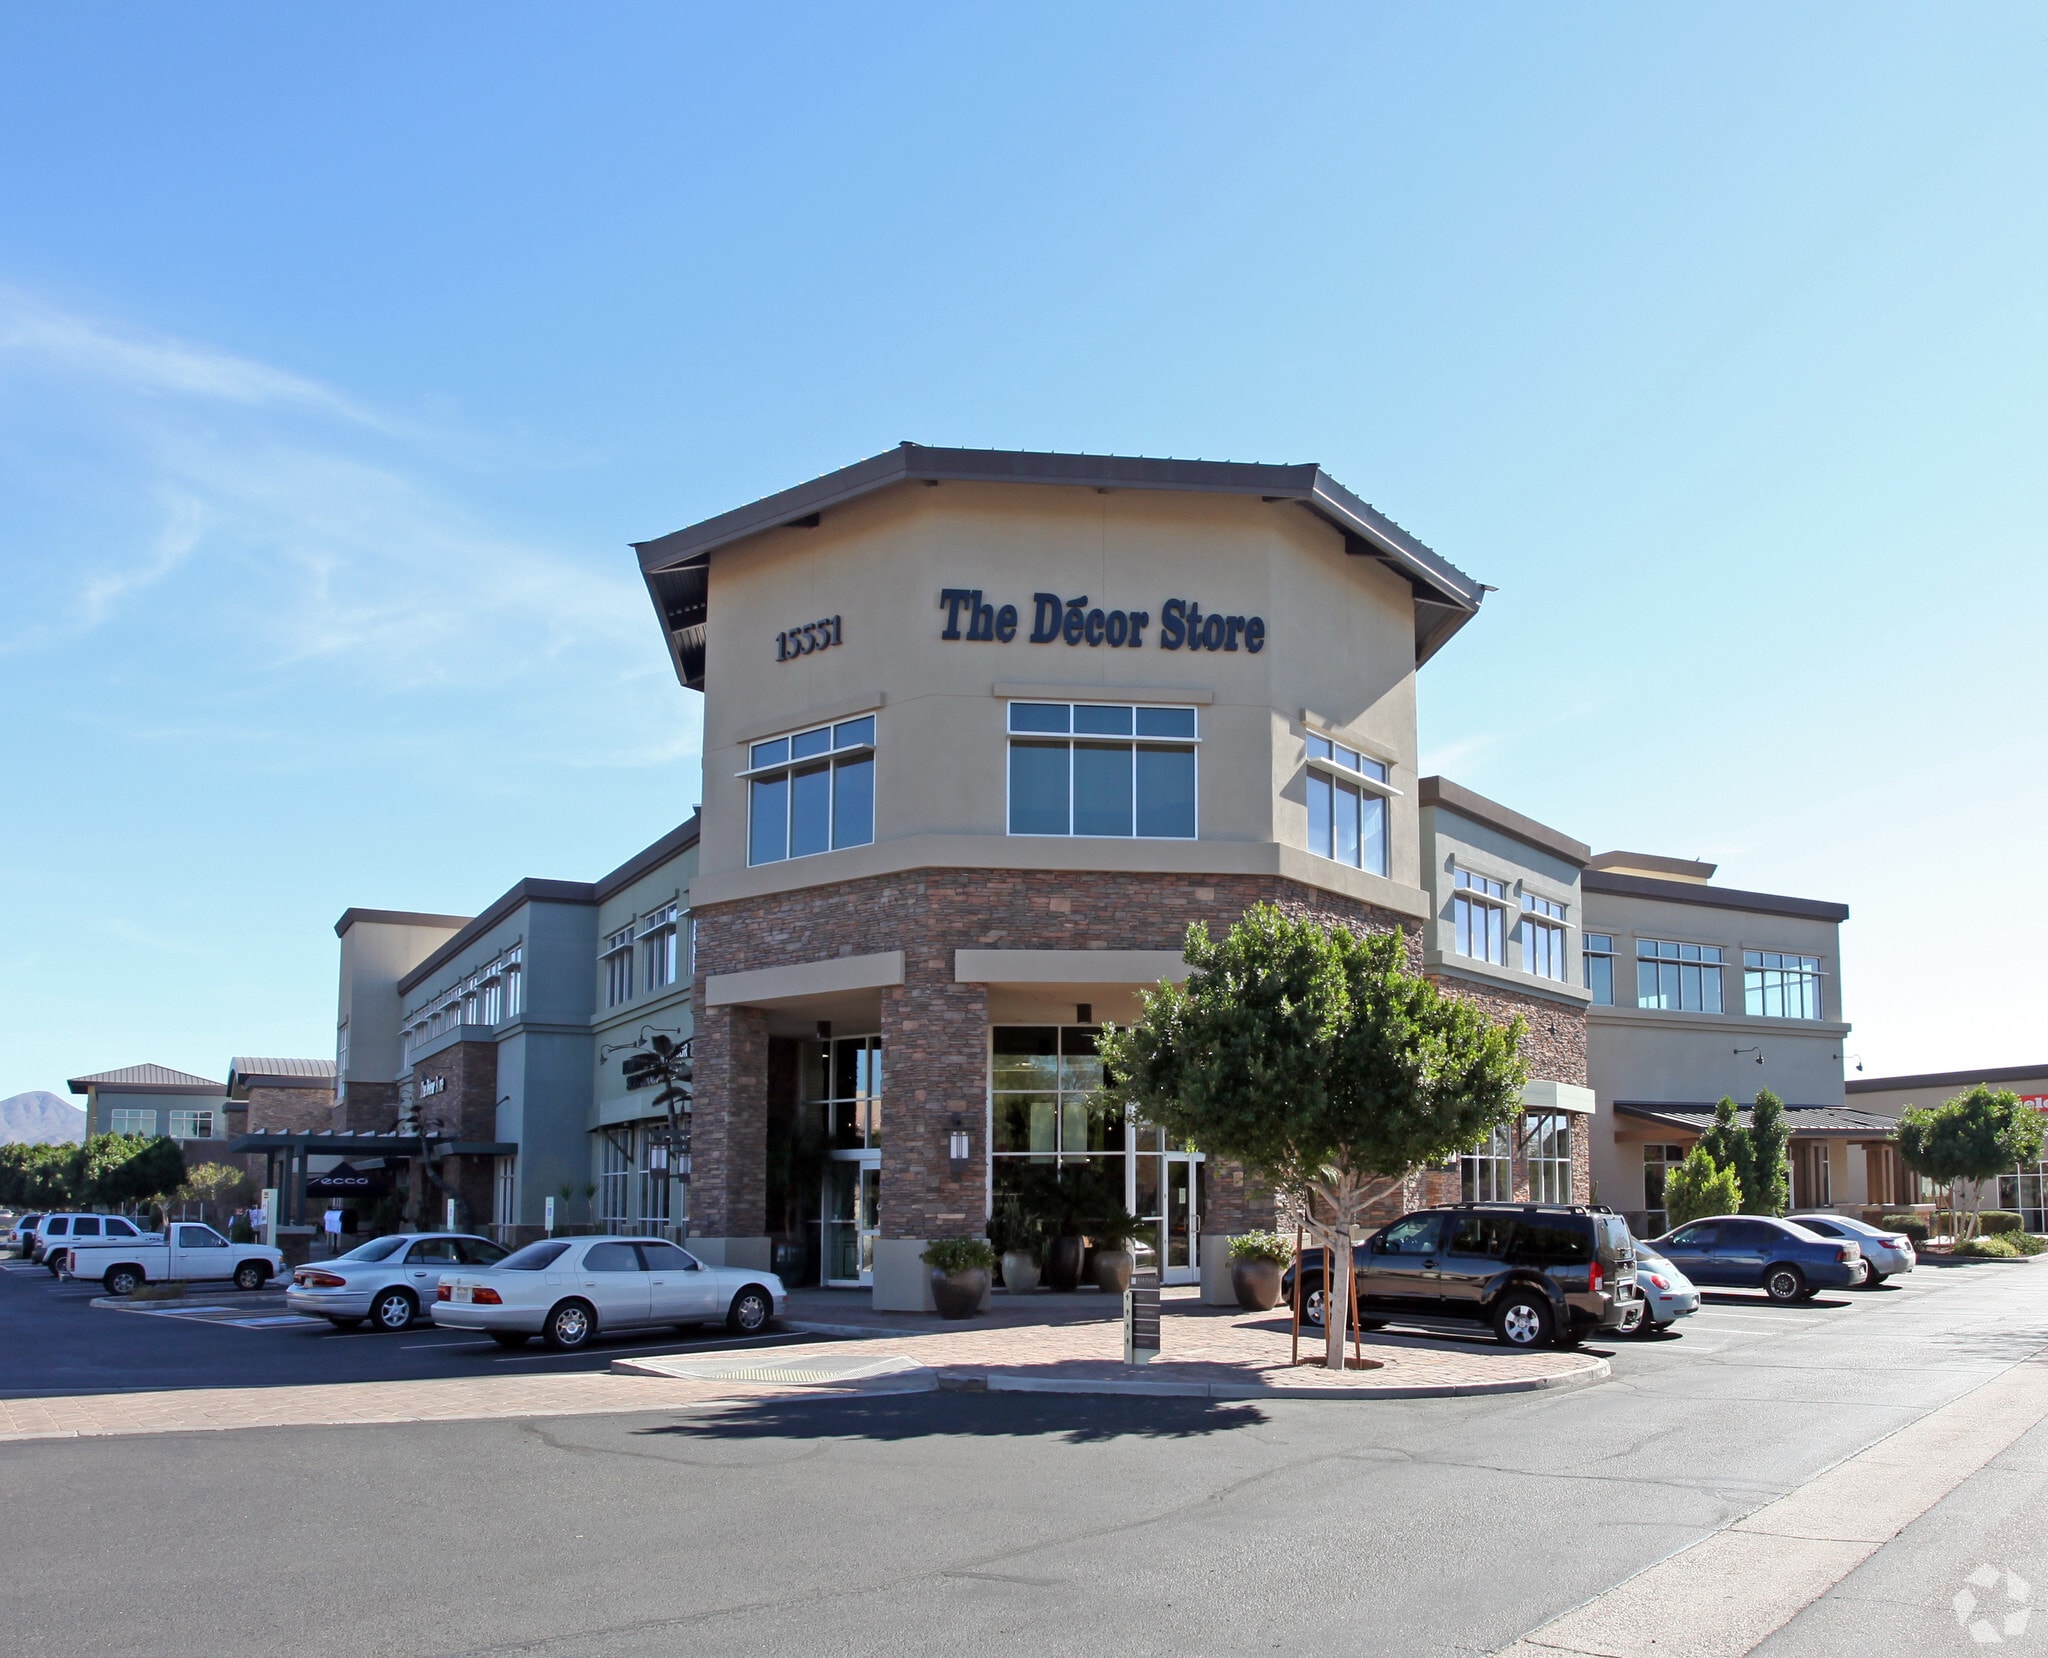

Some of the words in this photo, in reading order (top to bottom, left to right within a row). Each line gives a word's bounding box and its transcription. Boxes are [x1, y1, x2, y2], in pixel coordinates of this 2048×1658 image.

[775, 614, 843, 662] 15551
[940, 588, 1018, 643] The
[1029, 592, 1149, 647] Décor
[1160, 598, 1265, 654] Store
